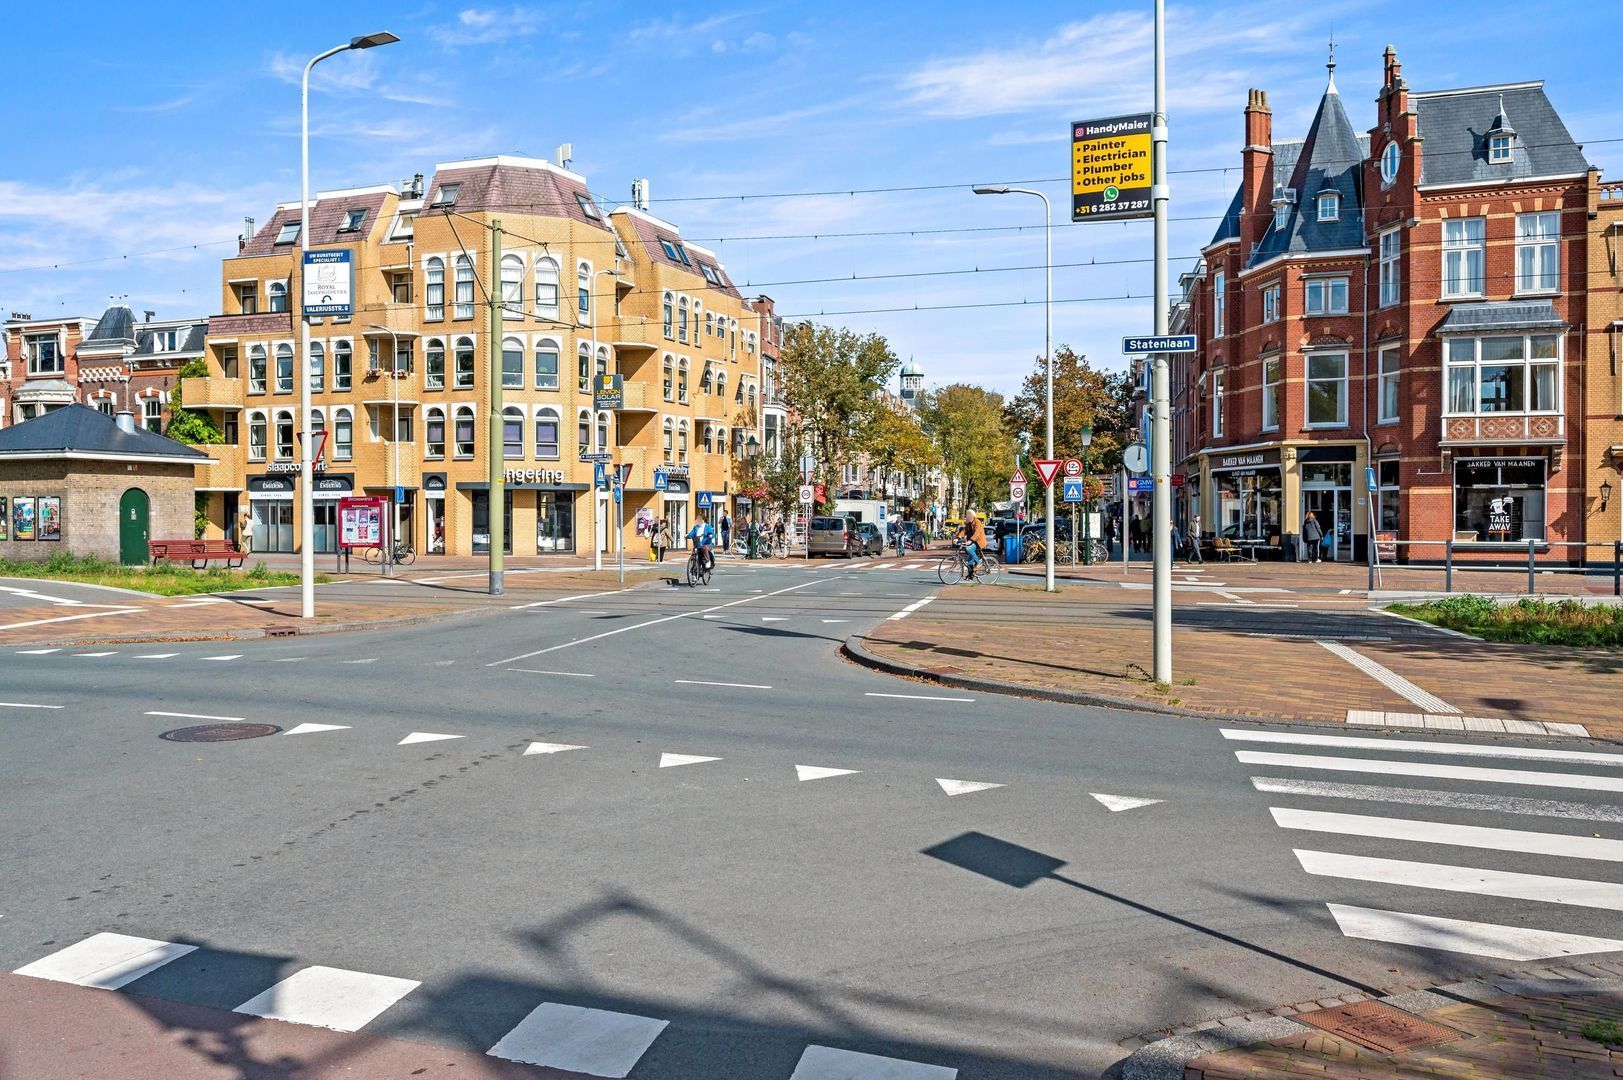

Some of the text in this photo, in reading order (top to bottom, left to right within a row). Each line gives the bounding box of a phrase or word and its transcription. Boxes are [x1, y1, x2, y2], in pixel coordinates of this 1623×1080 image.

[1086, 121, 1148, 134] HandyMaier
[1083, 141, 1126, 152] Painter
[1083, 150, 1146, 163] Electrician
[1083, 163, 1133, 175] Plumber
[1083, 173, 1145, 186] Other jobs
[1076, 200, 1149, 214] +31 6 282 37 287
[1129, 339, 1190, 349] Statenlaan
[1490, 515, 1510, 523] TAKE
